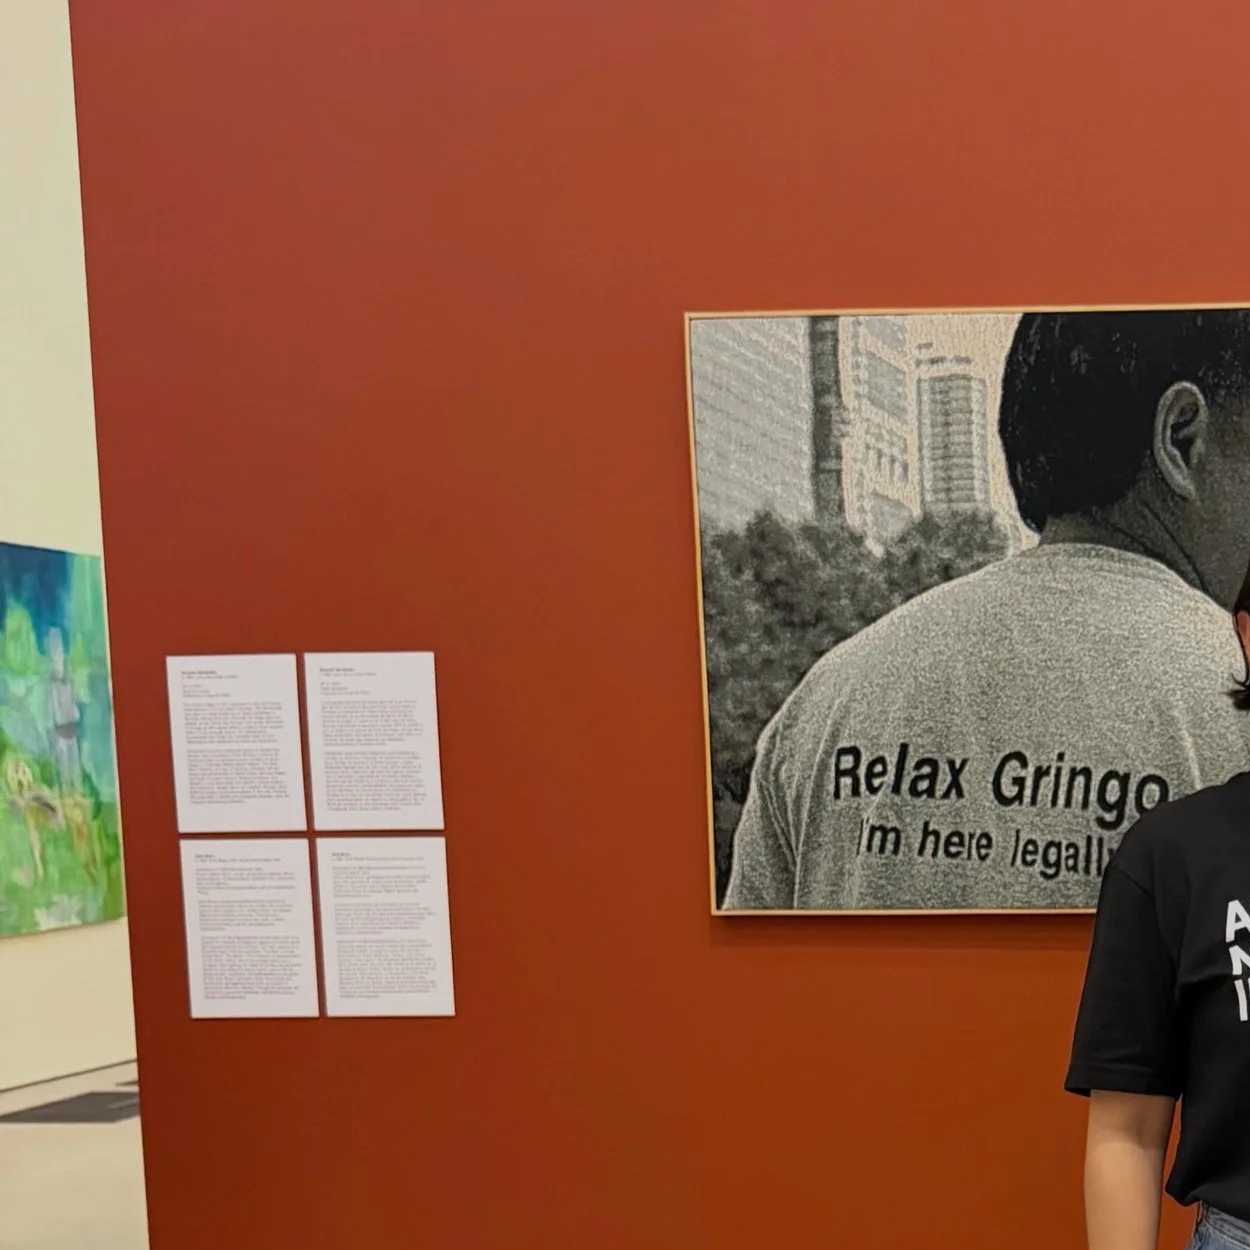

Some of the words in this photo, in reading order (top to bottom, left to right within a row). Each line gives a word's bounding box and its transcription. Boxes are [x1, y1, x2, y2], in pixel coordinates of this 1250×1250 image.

[832, 742, 969, 801] Relax
[991, 751, 1170, 831] Gringo
[917, 820, 993, 862] here
[1010, 829, 1118, 881] legall
